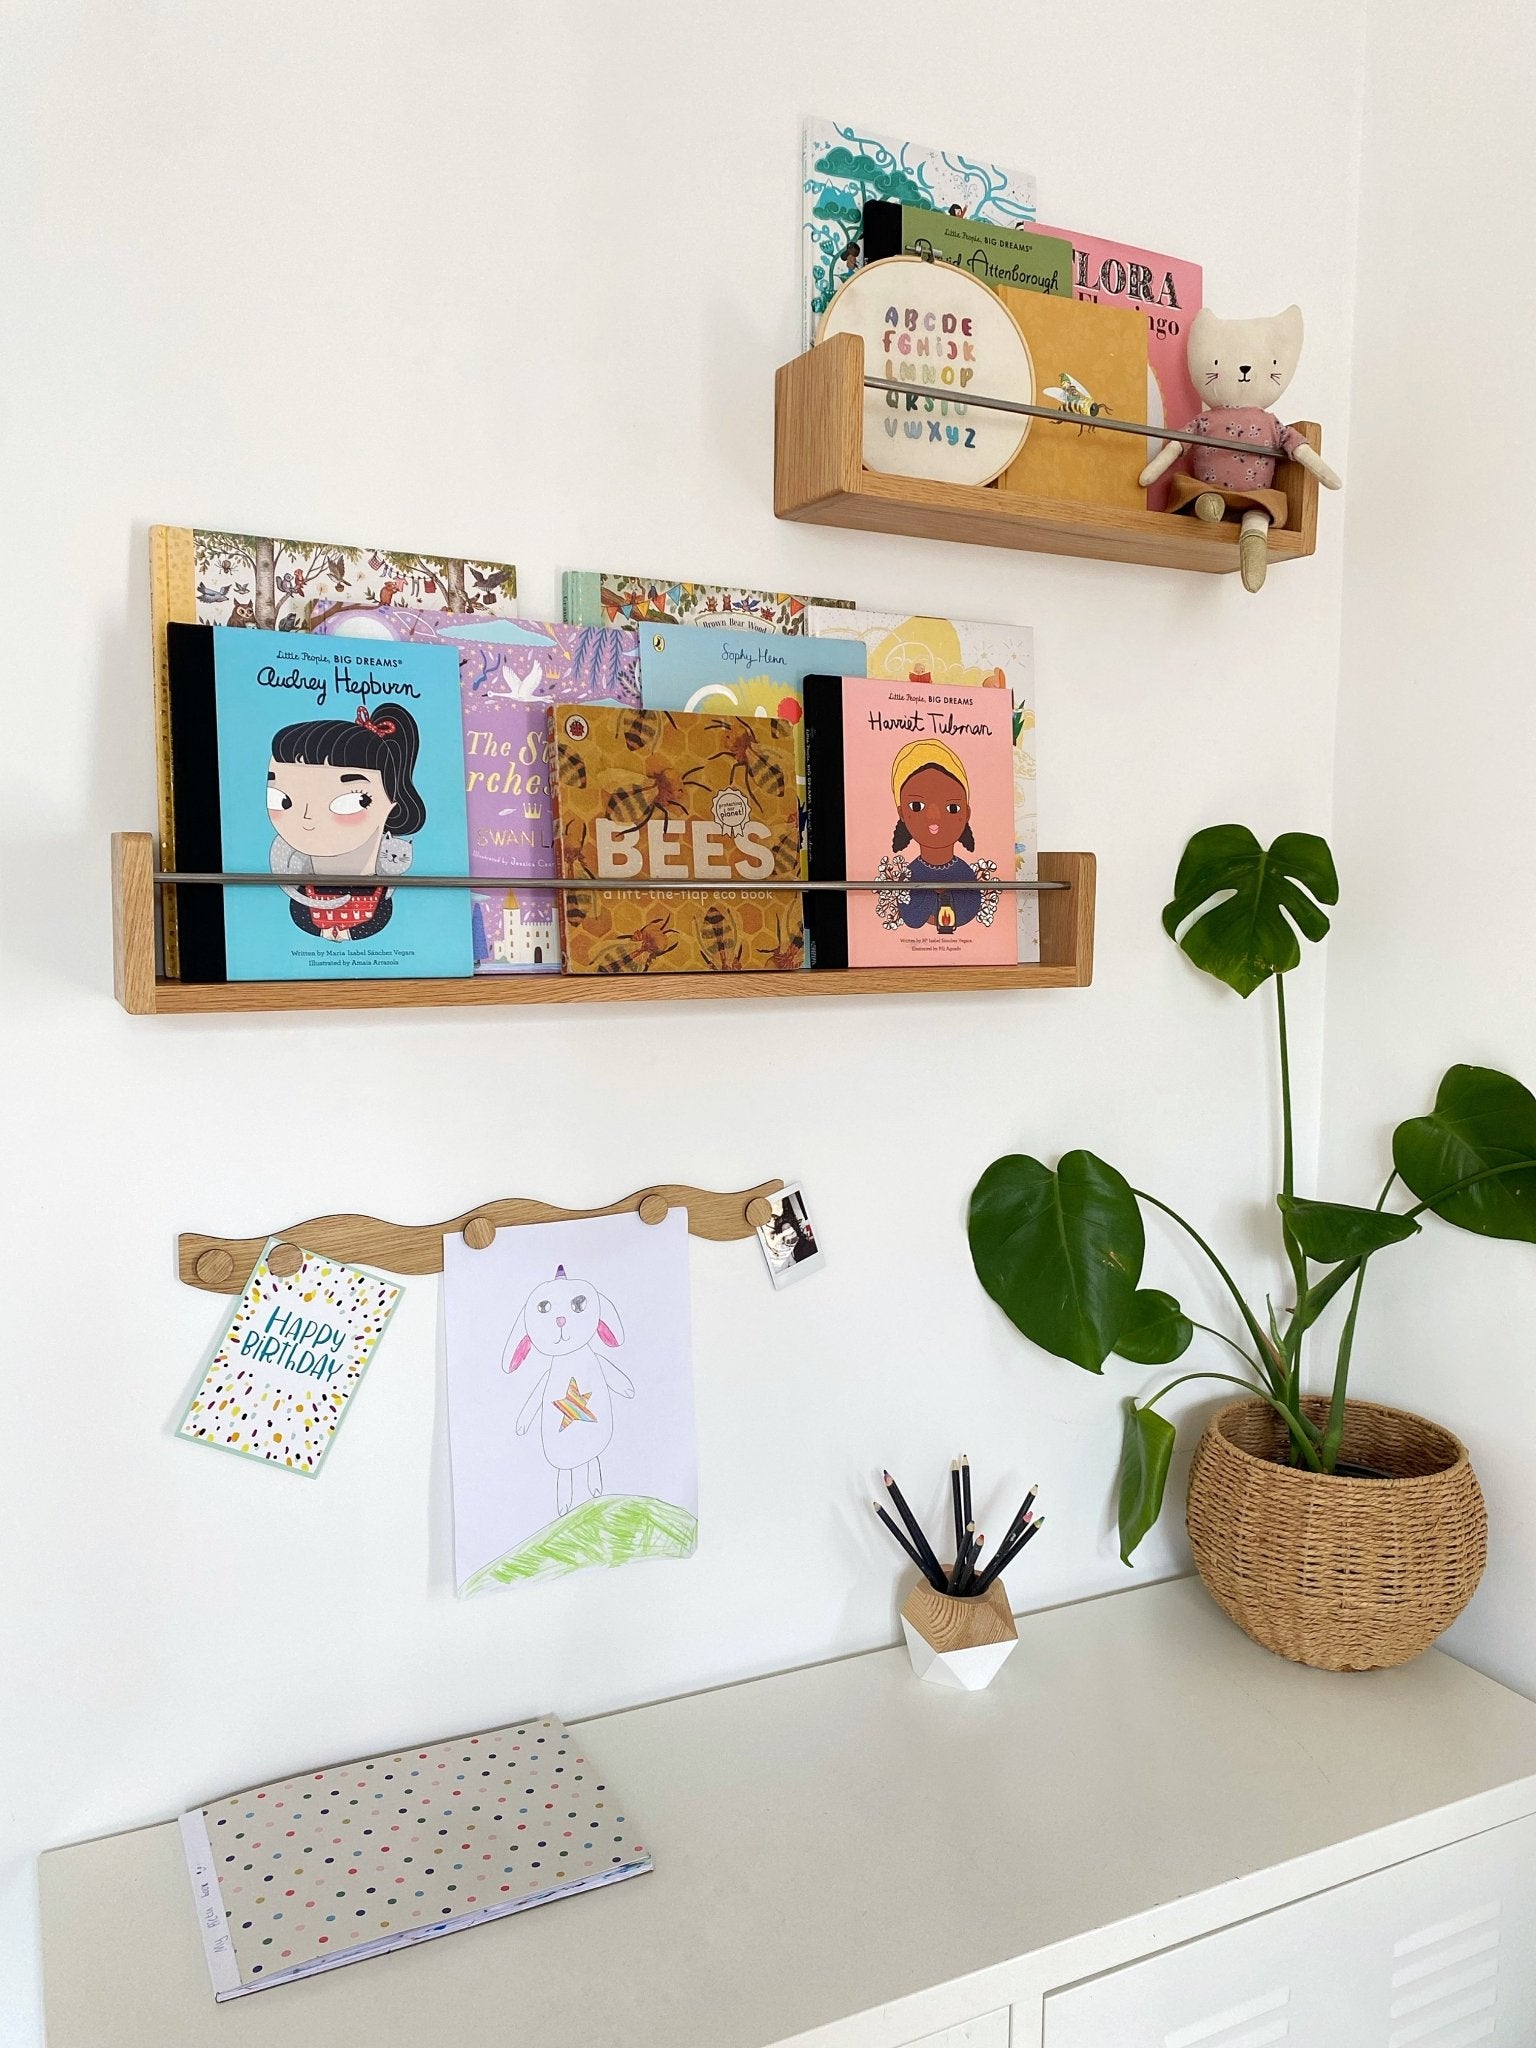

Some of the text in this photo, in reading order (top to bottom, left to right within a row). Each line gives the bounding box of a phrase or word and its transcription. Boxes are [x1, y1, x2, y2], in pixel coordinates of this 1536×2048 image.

[984, 236, 997, 246] BIG
[967, 249, 1059, 294] Attenborough
[1072, 249, 1182, 309] LORA
[702, 618, 767, 634] Brown Bear Wood
[276, 650, 300, 660] Little
[334, 655, 351, 664] BIG
[721, 642, 787, 669] Sophy Henn
[257, 666, 421, 705] Audrey Hepburn
[888, 692, 905, 701] Little
[943, 697, 974, 706] DREAMS
[868, 710, 993, 736] Harriet Tubman
[466, 730, 511, 757] The
[720, 806, 744, 821] planet!
[477, 828, 536, 848] SWAN
[595, 817, 775, 880] BEES
[603, 890, 612, 900] a
[713, 890, 737, 900] eco
[741, 889, 773, 900] book
[309, 959, 341, 967] Illustrated
[342, 959, 350, 967] by
[317, 950, 325, 959] by
